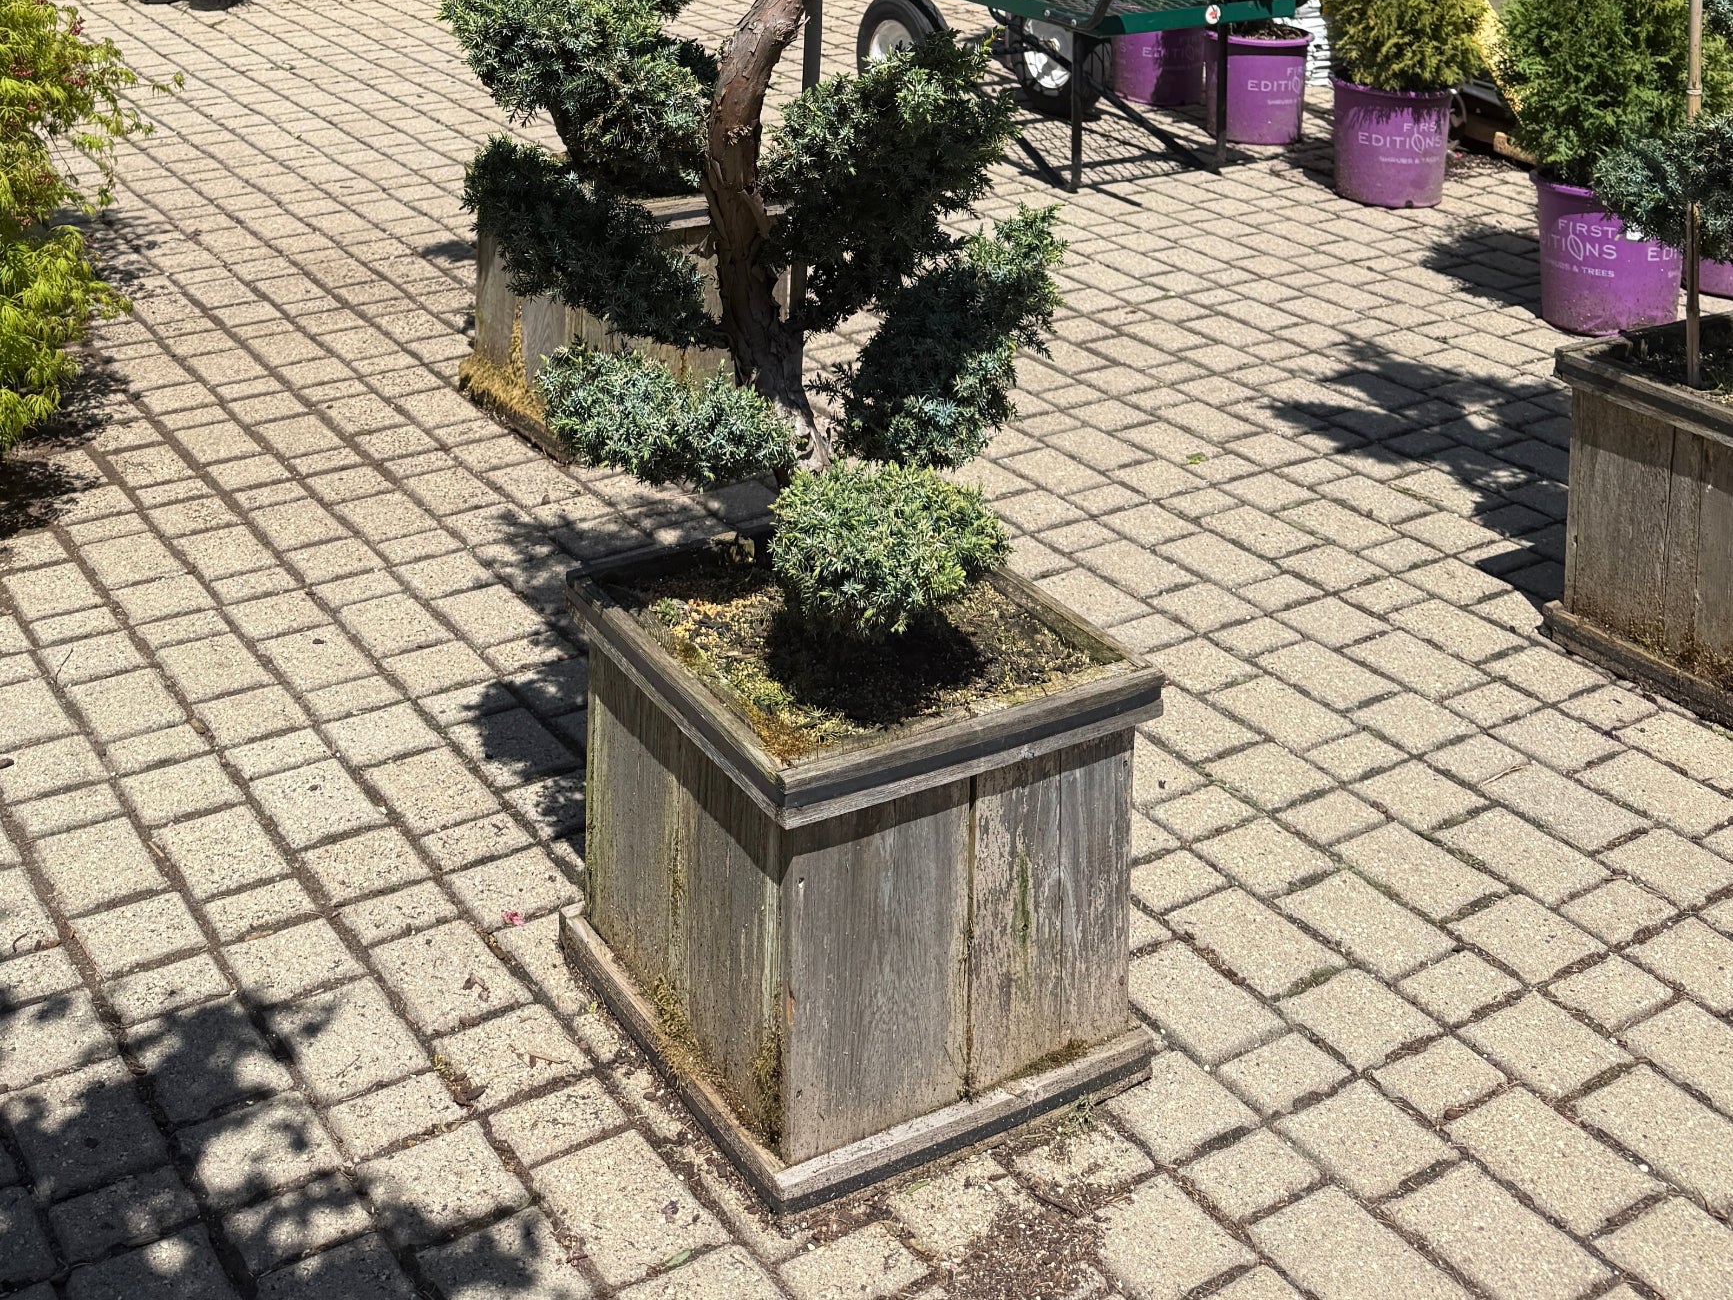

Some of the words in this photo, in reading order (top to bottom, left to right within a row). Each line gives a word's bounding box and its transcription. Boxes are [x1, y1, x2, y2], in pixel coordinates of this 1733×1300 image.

[1358, 131, 1443, 153] EDITIONS
[1558, 219, 1617, 239] FIRST
[1572, 264, 1579, 273] &
[1581, 266, 1615, 278] TREES
